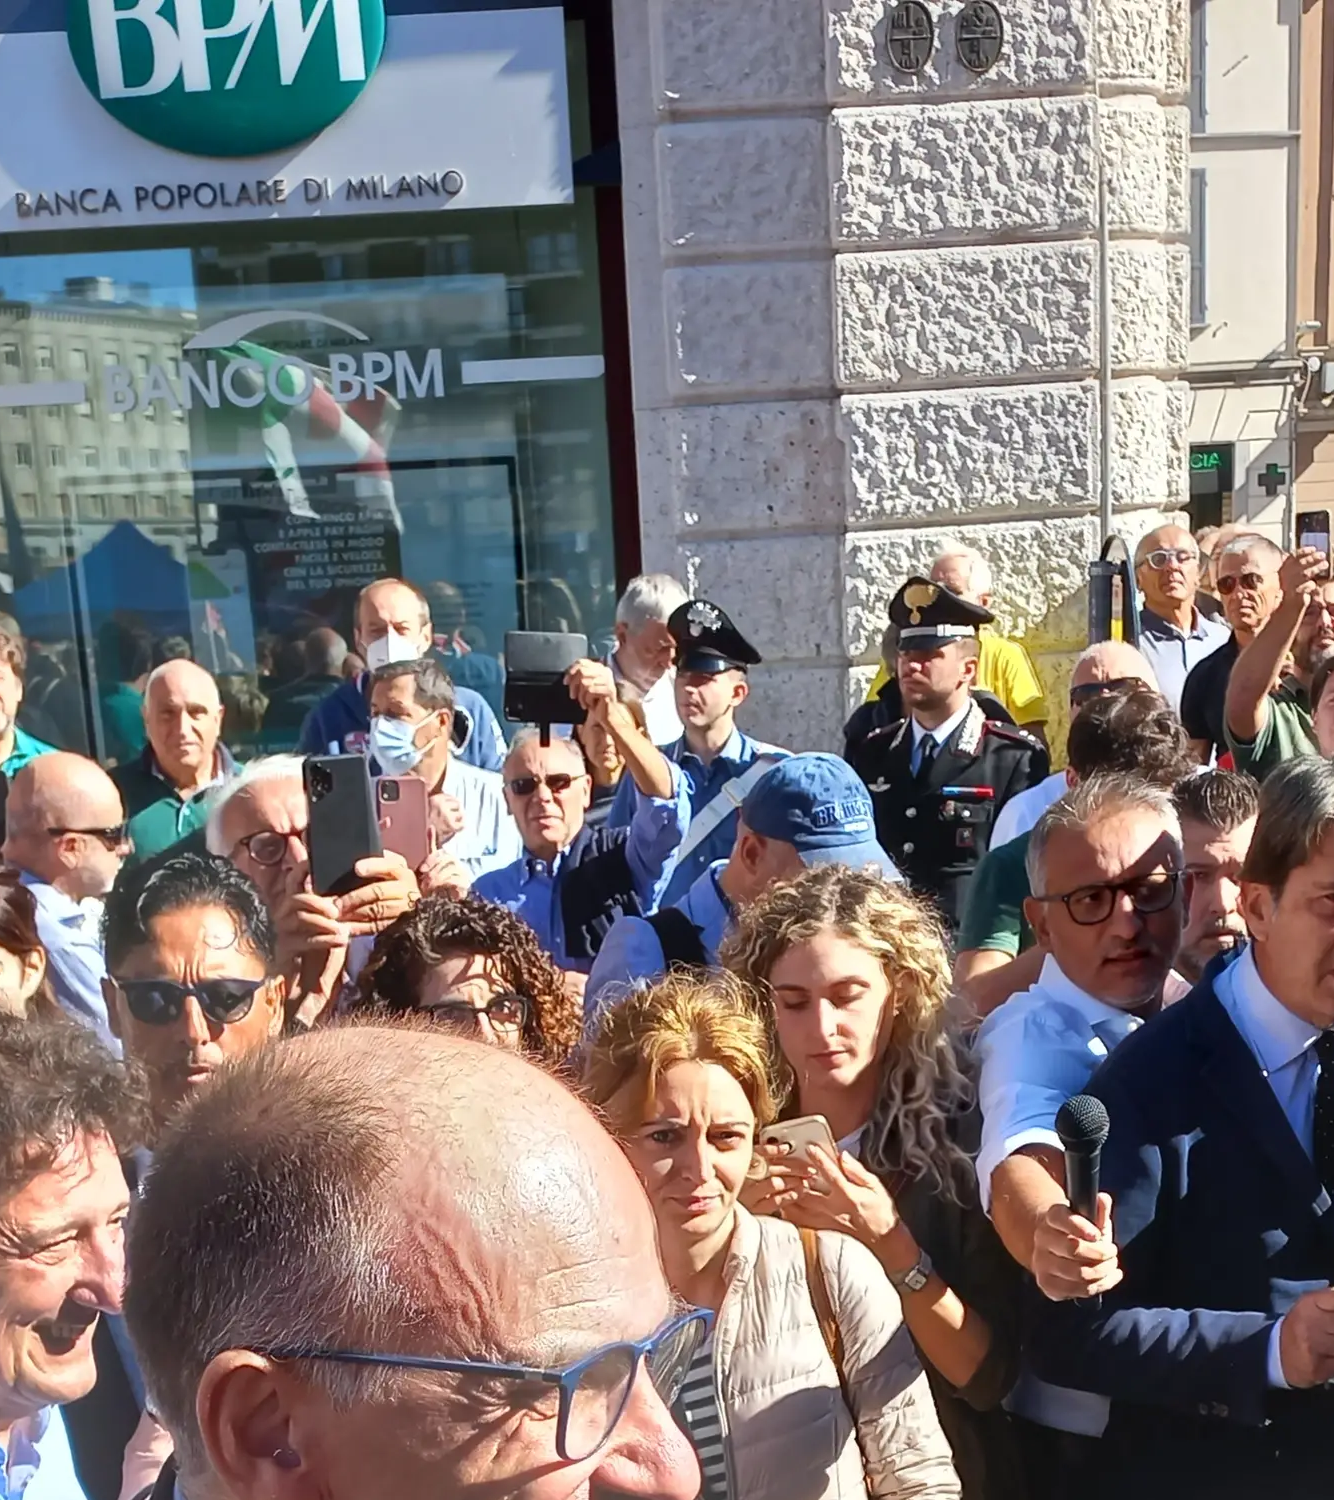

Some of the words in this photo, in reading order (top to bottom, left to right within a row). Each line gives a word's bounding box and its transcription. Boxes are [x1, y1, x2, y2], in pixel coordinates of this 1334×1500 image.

[87, 0, 366, 99] BPM
[15, 188, 123, 219] BANCA
[135, 178, 287, 212] POPOLARE
[304, 175, 331, 203] DI
[346, 168, 464, 200] MILANO
[105, 354, 312, 414] BANCO
[332, 348, 444, 401] BPM
